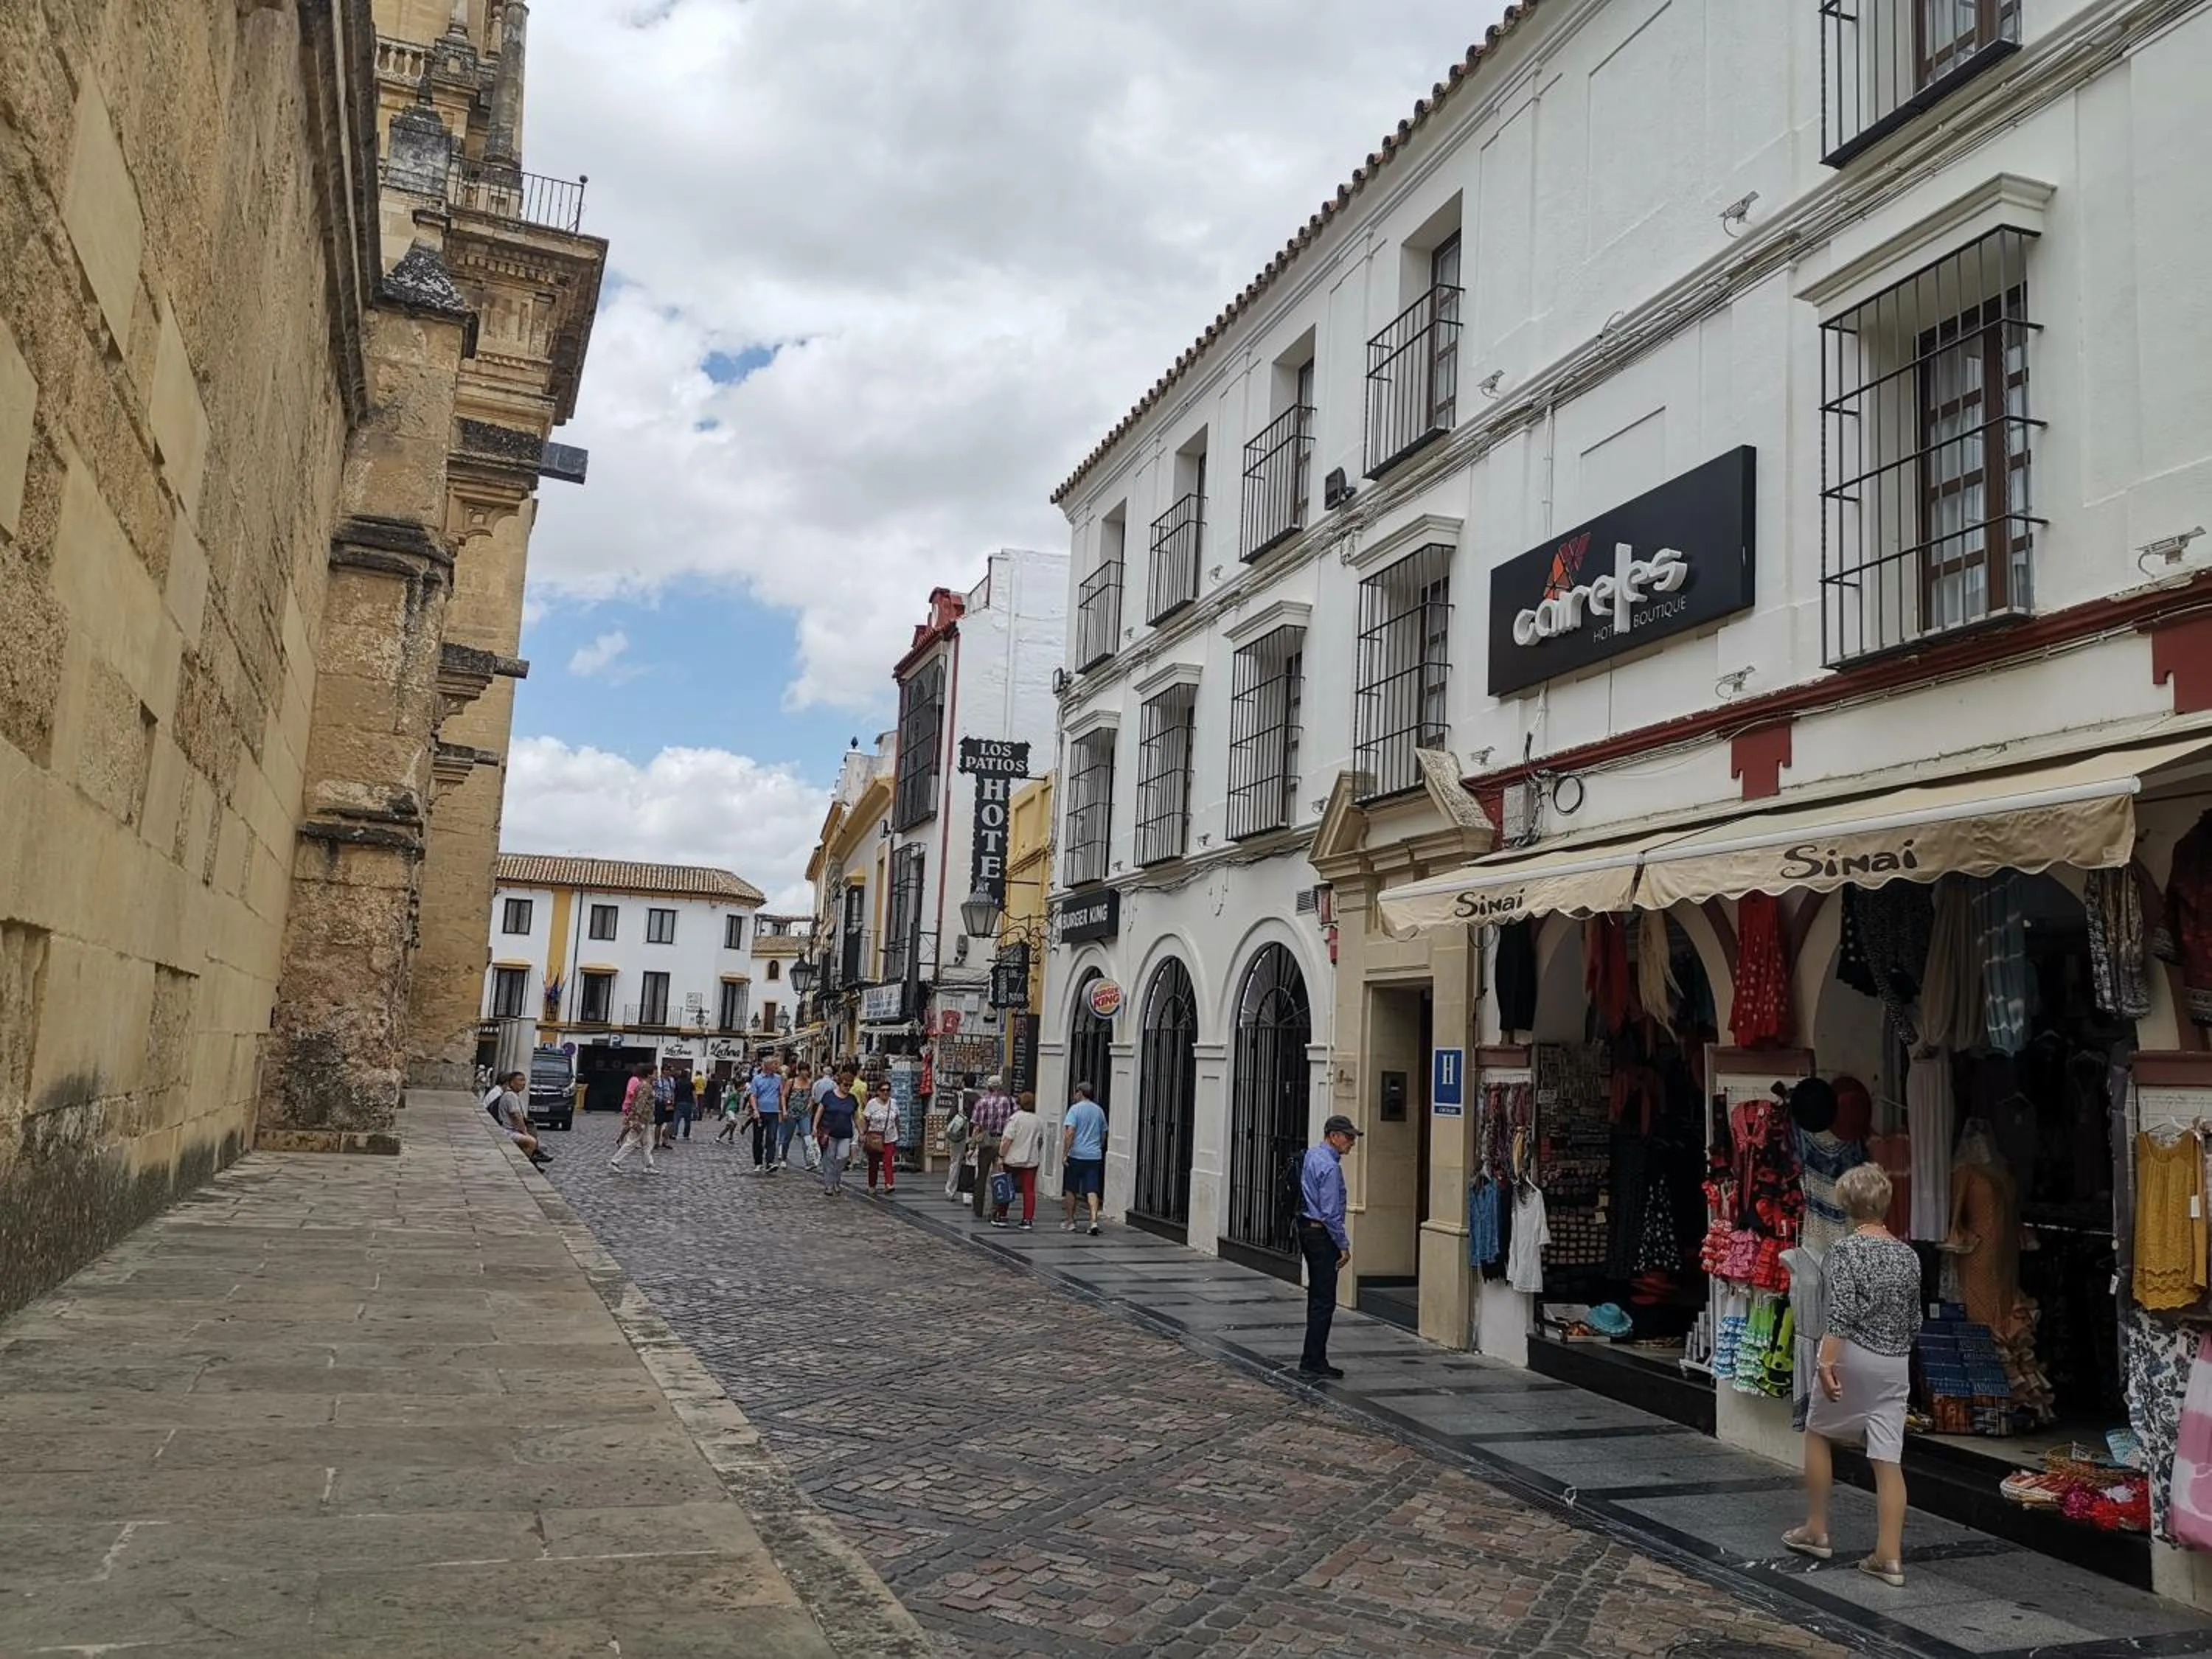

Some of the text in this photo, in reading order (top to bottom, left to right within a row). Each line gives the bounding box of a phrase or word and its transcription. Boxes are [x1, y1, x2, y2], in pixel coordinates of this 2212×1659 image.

[1633, 595, 1687, 628] BOUTIQUE
[980, 742, 1012, 757] LOS
[965, 756, 1026, 772] PATIOS
[980, 778, 1006, 905] HOTE
[1062, 902, 1108, 930] BURGER KING
[1093, 994, 1120, 1008] KING
[610, 1034, 620, 1047] P
[1442, 1054, 1455, 1085] H
